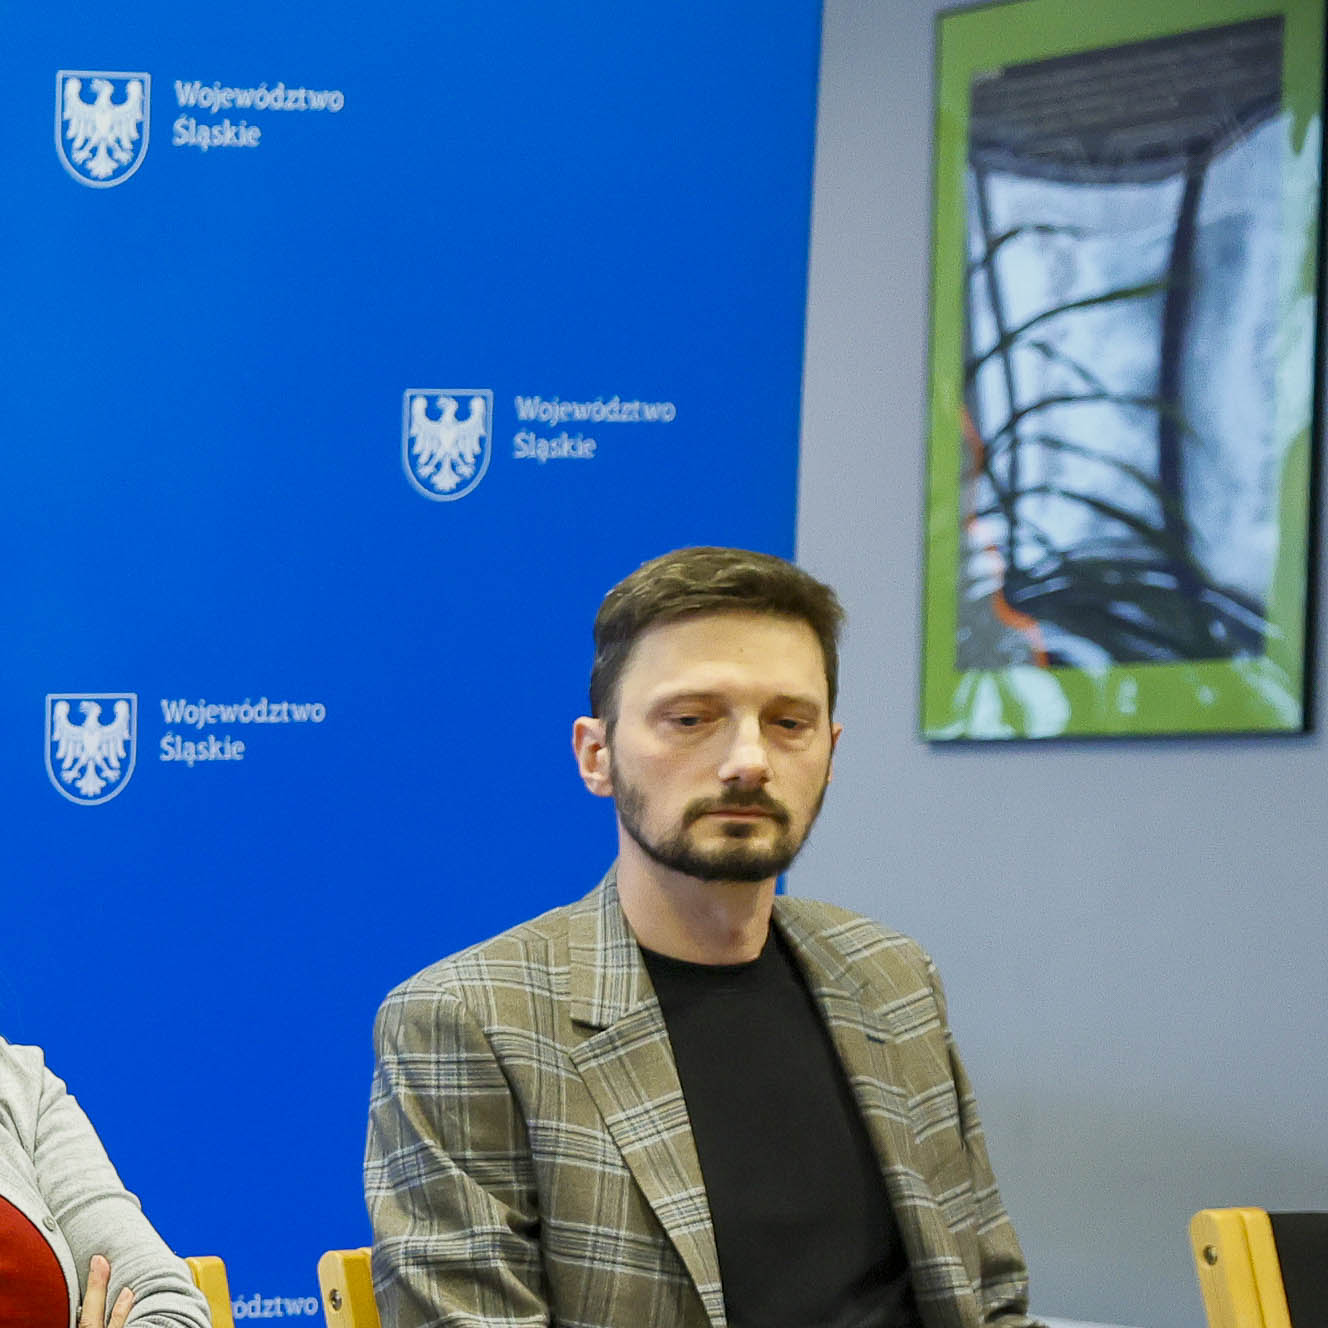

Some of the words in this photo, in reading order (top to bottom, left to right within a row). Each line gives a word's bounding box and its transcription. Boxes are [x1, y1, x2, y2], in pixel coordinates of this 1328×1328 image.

[174, 79, 345, 113] Województwo
[174, 115, 262, 150] Śląskie
[515, 395, 676, 426] Województwo
[514, 431, 597, 462] Śląskie
[160, 697, 326, 730] Województwo
[160, 731, 246, 765] Śląskie
[232, 1292, 319, 1320] ództwo
